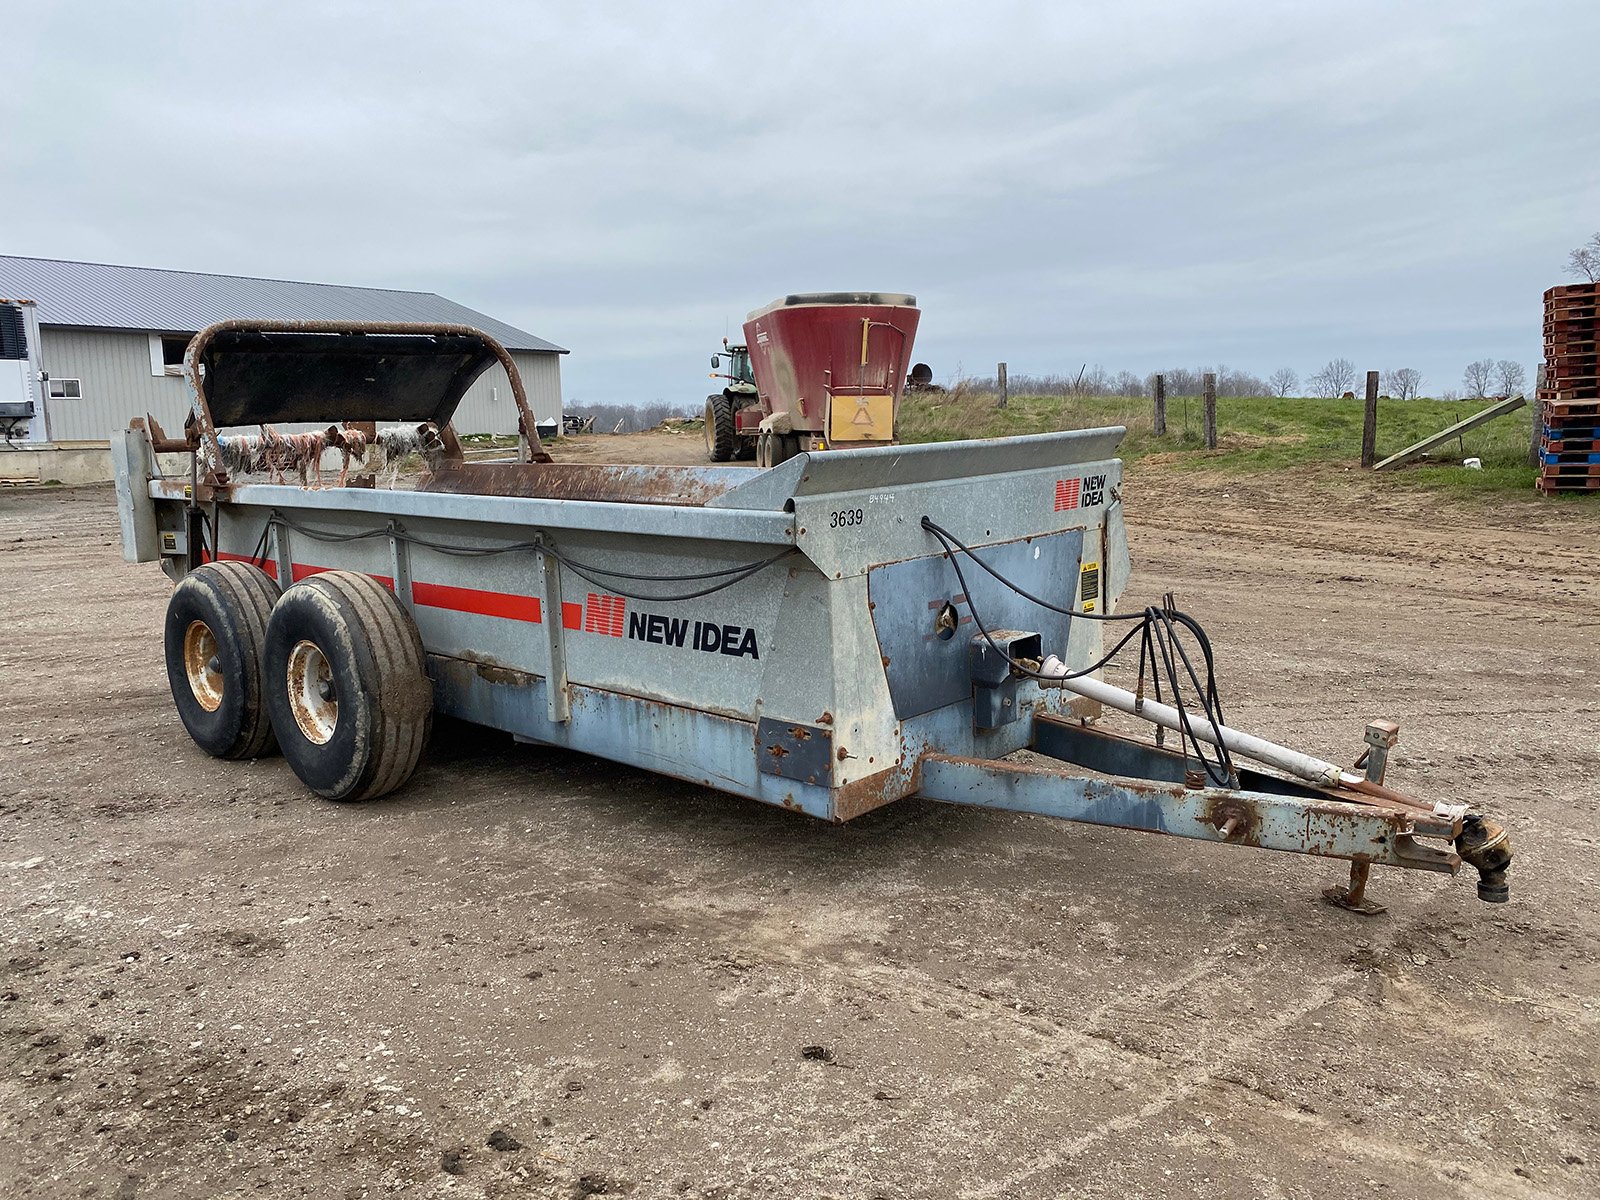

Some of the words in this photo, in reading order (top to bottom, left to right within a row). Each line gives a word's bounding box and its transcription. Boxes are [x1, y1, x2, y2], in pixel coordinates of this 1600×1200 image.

[1083, 475, 1106, 492] NEW
[1081, 491, 1104, 507] IDEA
[829, 508, 863, 528] 3639
[628, 611, 689, 647] NEW
[693, 621, 759, 660] IDEA
